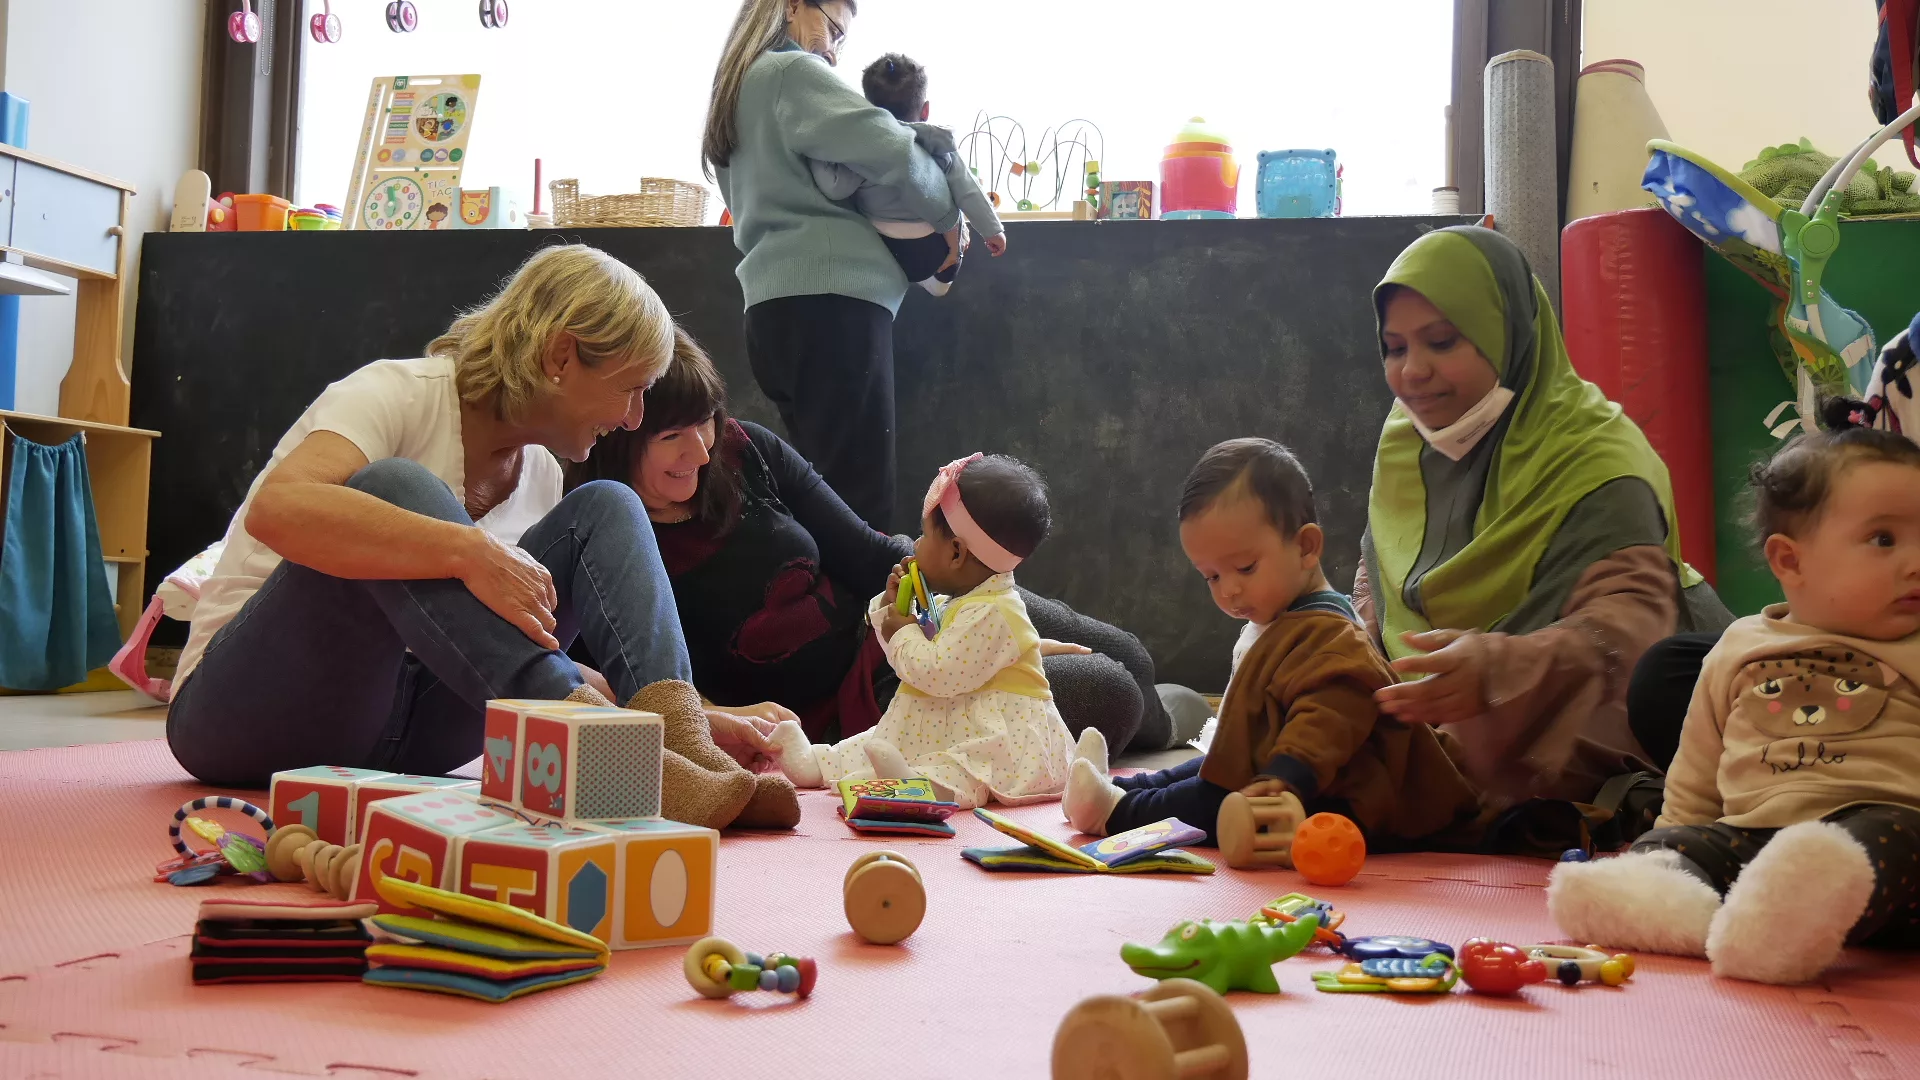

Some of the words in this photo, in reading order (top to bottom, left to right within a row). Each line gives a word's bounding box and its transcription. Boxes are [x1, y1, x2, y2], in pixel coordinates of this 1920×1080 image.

[428, 180, 446, 189] TIC
[485, 735, 513, 783] 4
[527, 742, 562, 793] 8
[1761, 741, 1847, 775] hello
[287, 791, 320, 834] 1
[369, 838, 433, 909] G
